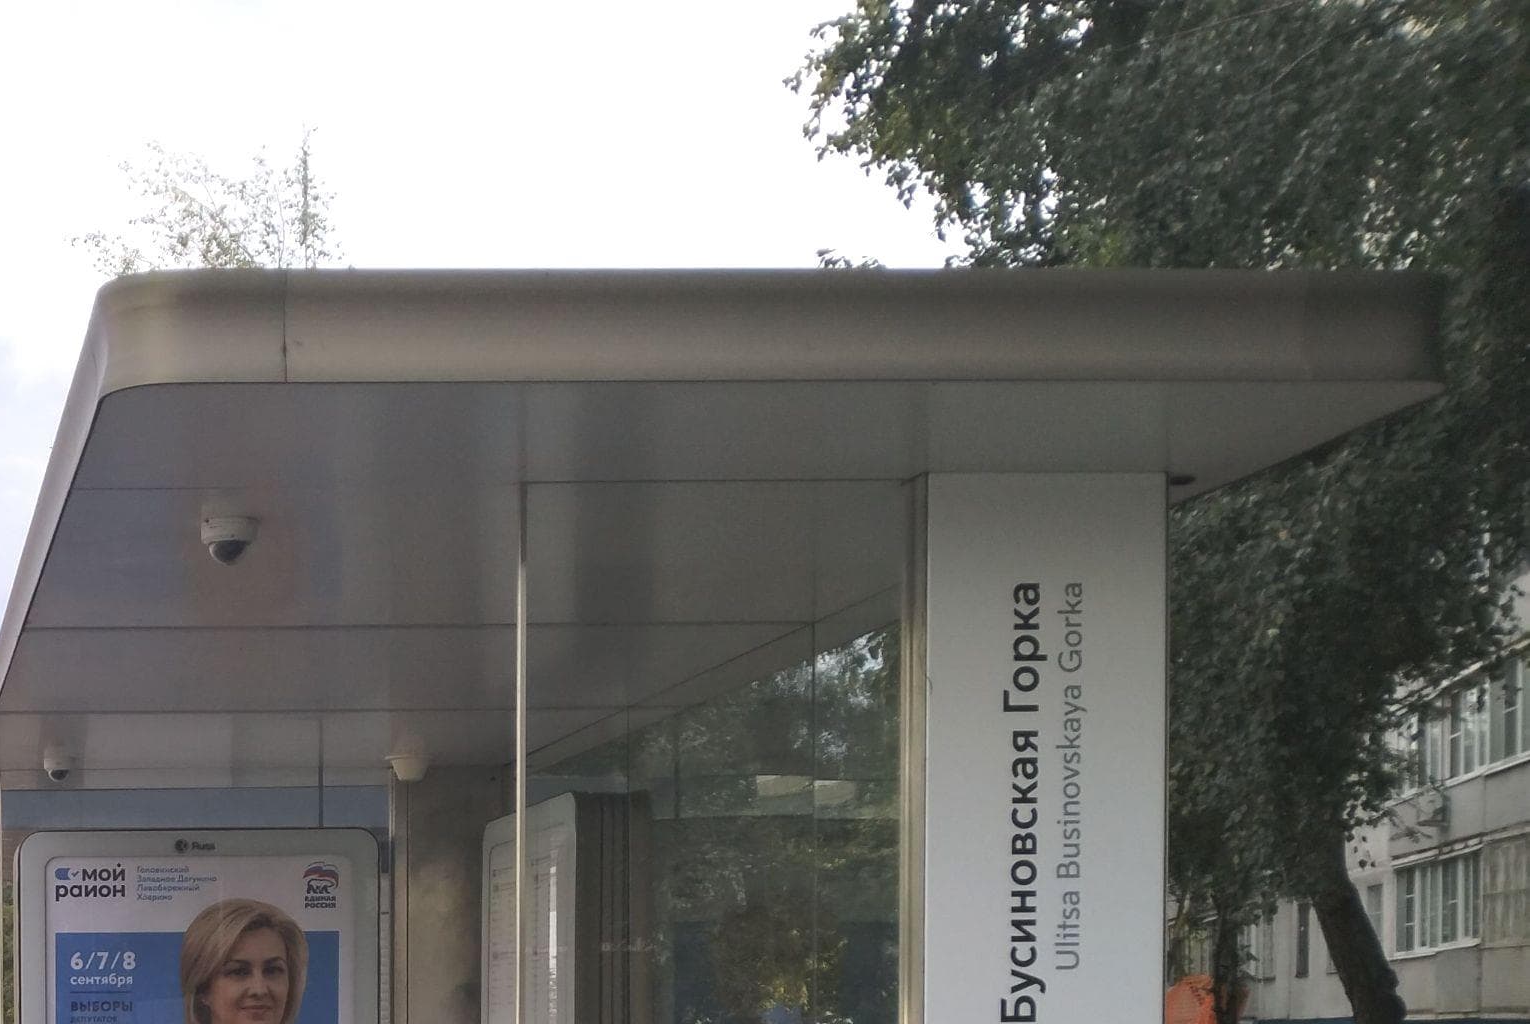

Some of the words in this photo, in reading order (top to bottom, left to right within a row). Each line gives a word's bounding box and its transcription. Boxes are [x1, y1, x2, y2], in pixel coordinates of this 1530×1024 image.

[1002, 582, 1048, 712] Горка
[1056, 582, 1083, 672] Gorka
[1055, 684, 1087, 879] Businovskaya
[1000, 730, 1046, 1023] Бусиновская
[70, 951, 136, 970] 6/7/8
[1054, 890, 1080, 971] Ulitsa
[70, 973, 134, 987] сентября
[70, 1001, 134, 1012] ВЫБОРЫ
